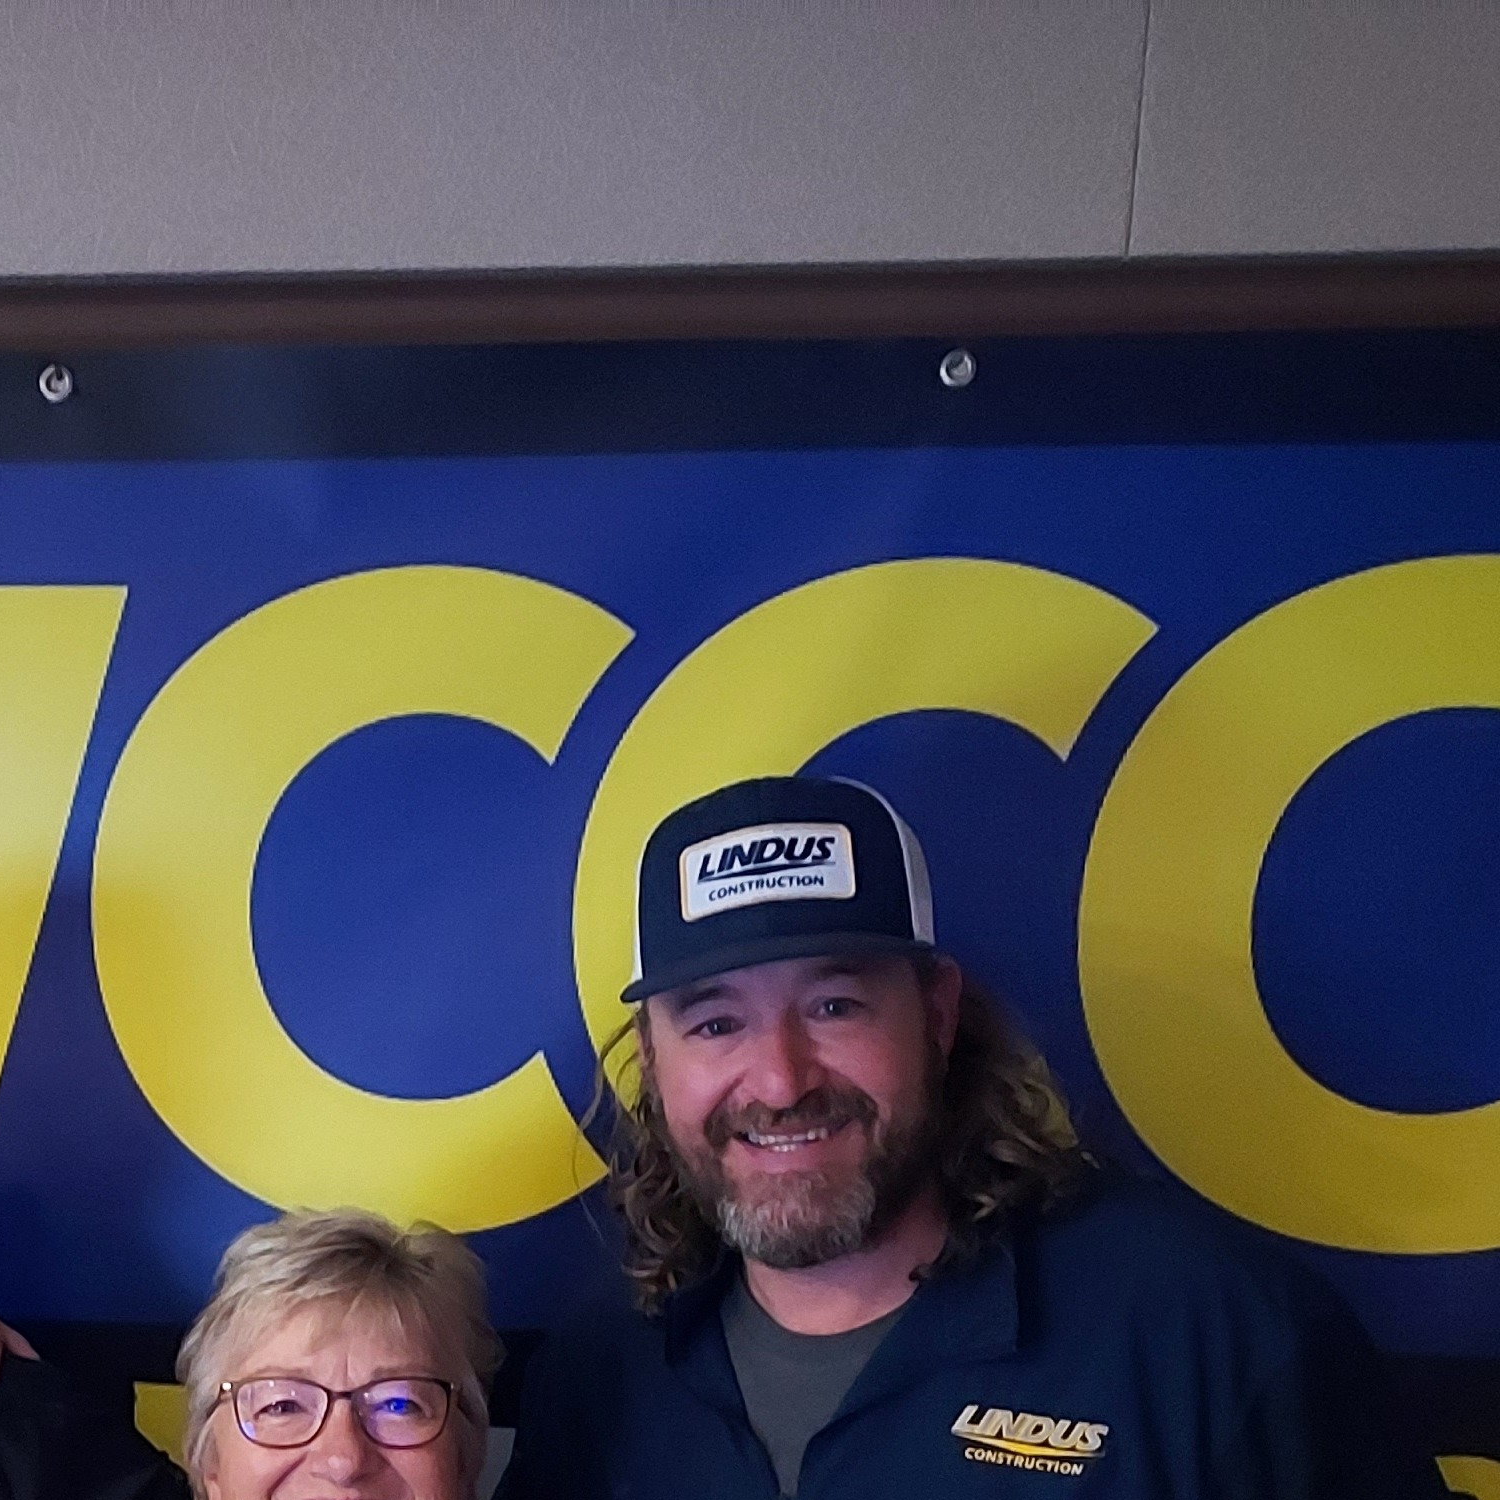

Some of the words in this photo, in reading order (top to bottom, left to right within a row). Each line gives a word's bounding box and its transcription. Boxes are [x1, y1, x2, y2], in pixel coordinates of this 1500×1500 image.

[697, 836, 835, 880] LINDUS
[708, 874, 824, 901] CONSTRUCTION
[950, 1404, 1109, 1451] LINDUS
[964, 1446, 1084, 1476] CONSTRUCTION
